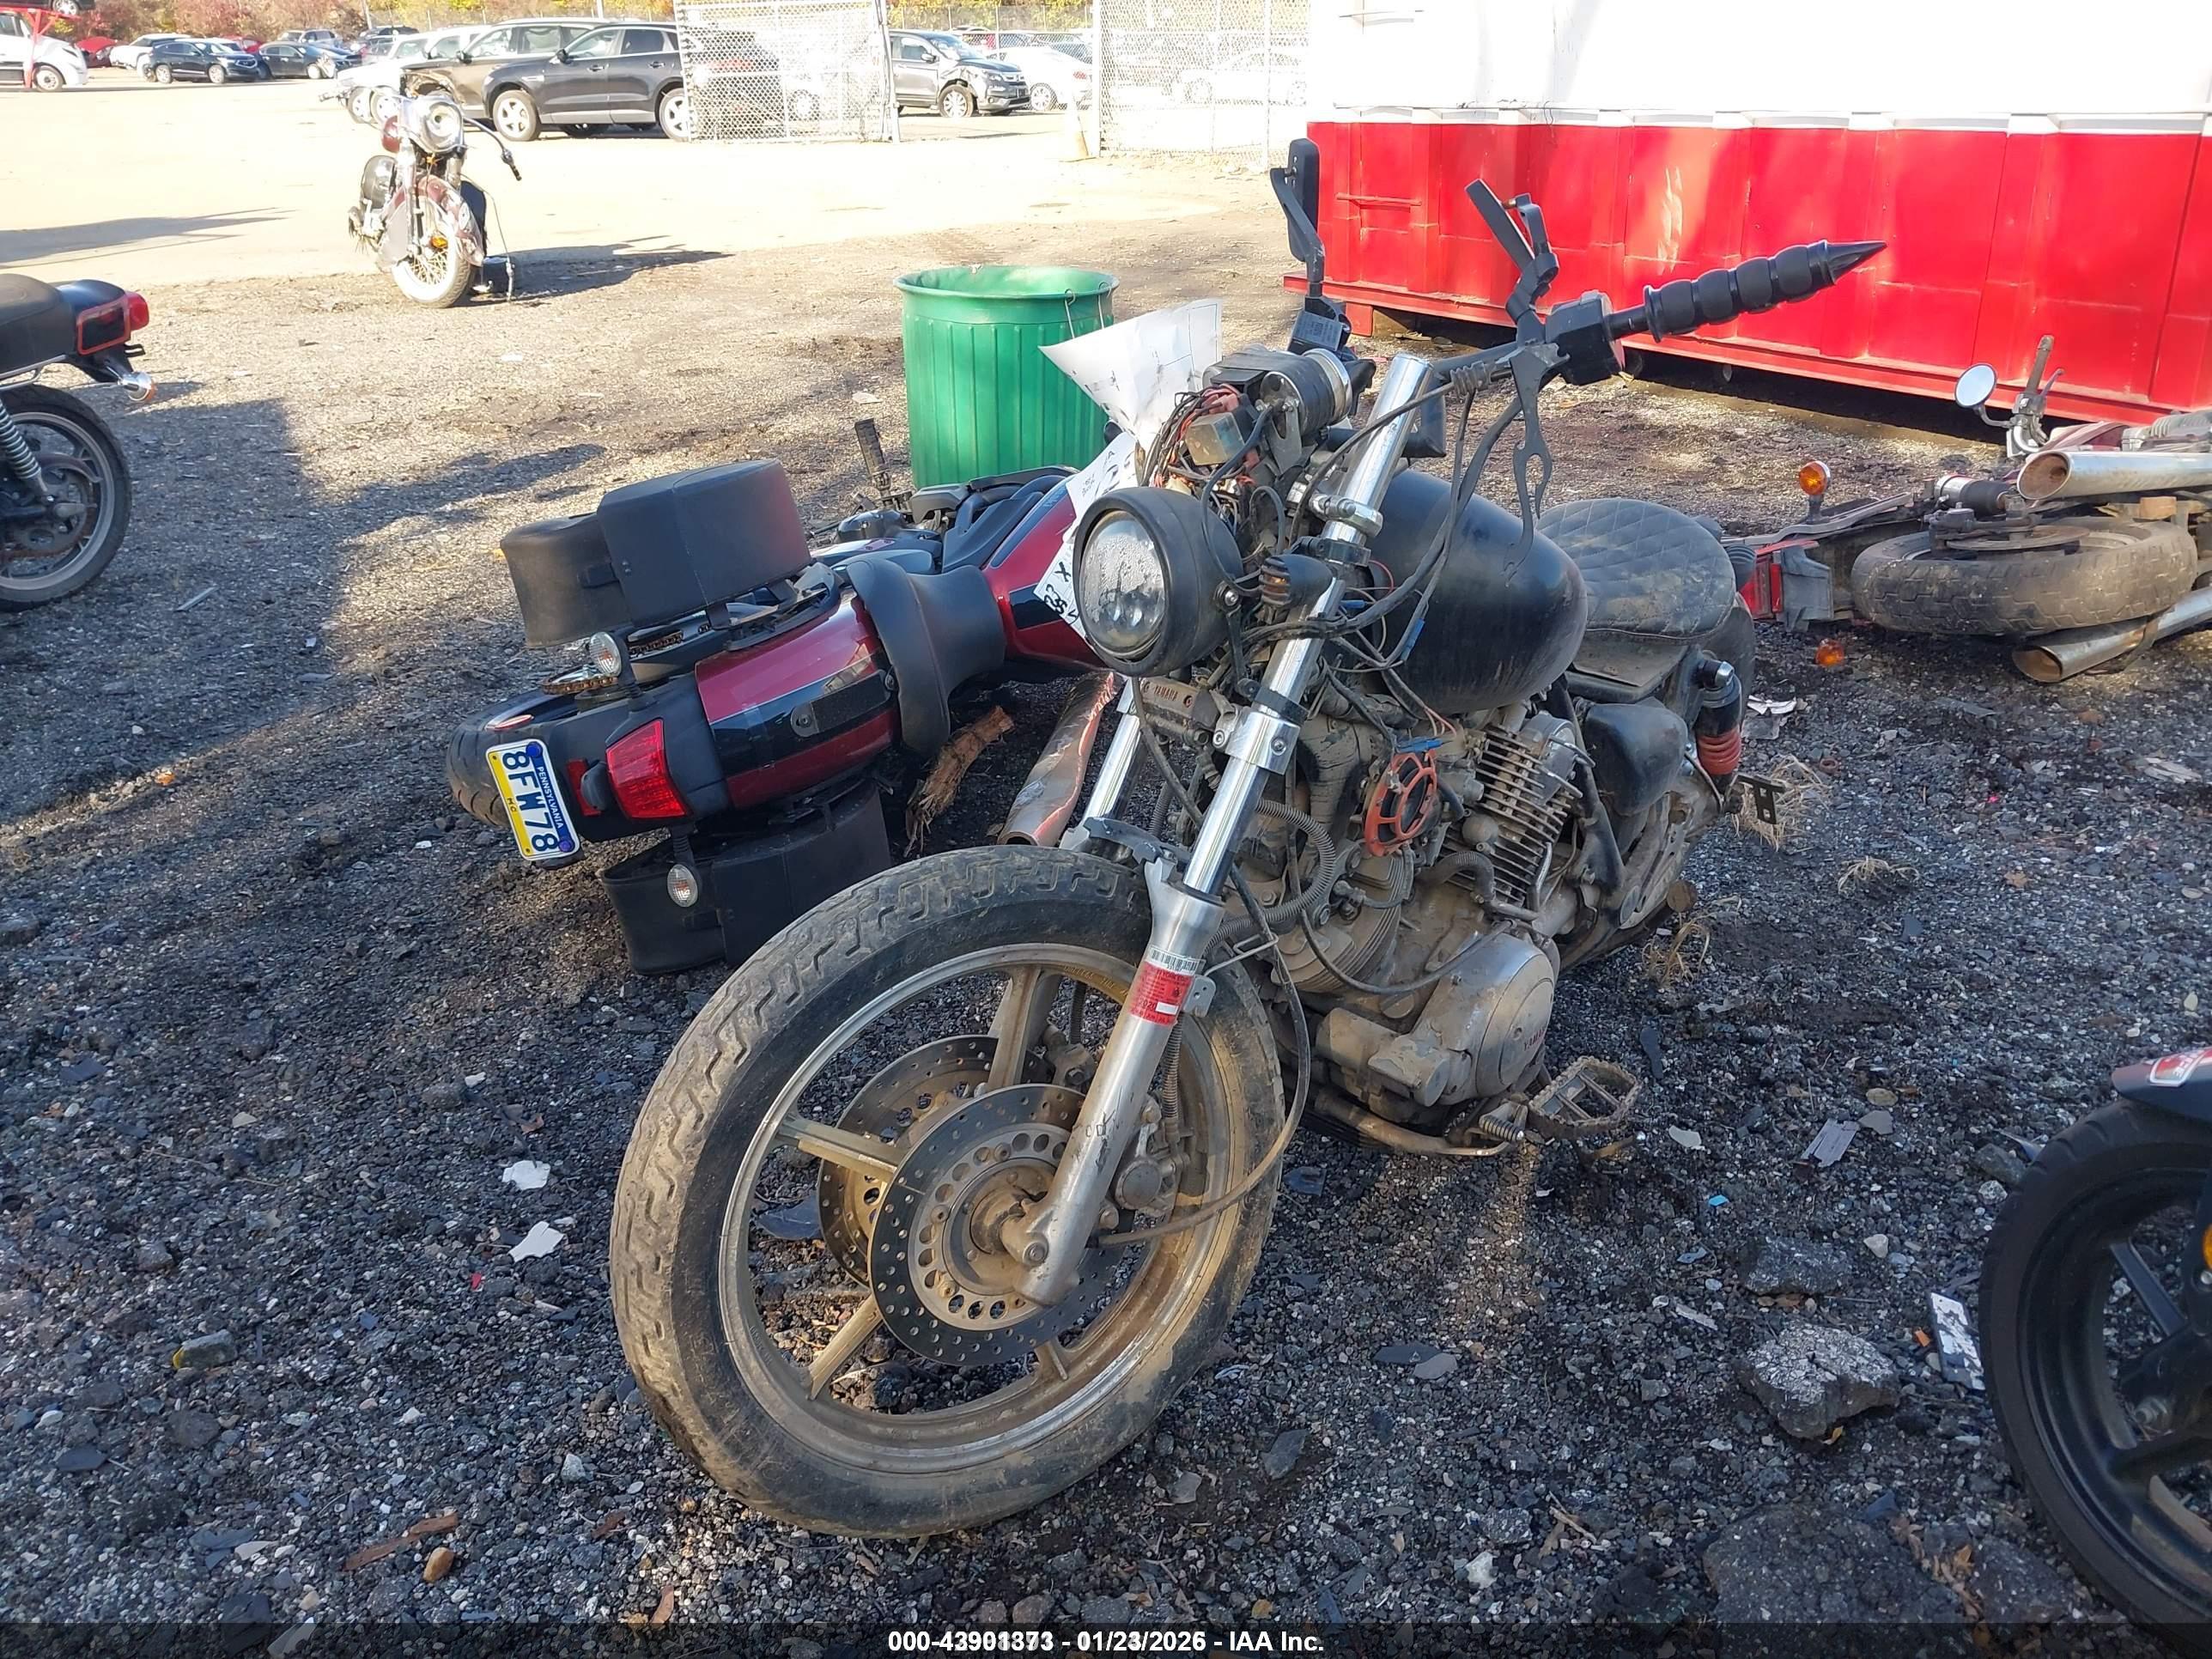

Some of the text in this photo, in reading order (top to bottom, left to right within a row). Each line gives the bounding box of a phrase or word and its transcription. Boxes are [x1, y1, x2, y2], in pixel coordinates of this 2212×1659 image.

[1153, 684, 1178, 702] YAMAHA
[502, 751, 559, 852] 8FW78
[537, 766, 564, 830] PENNSYLVANIA
